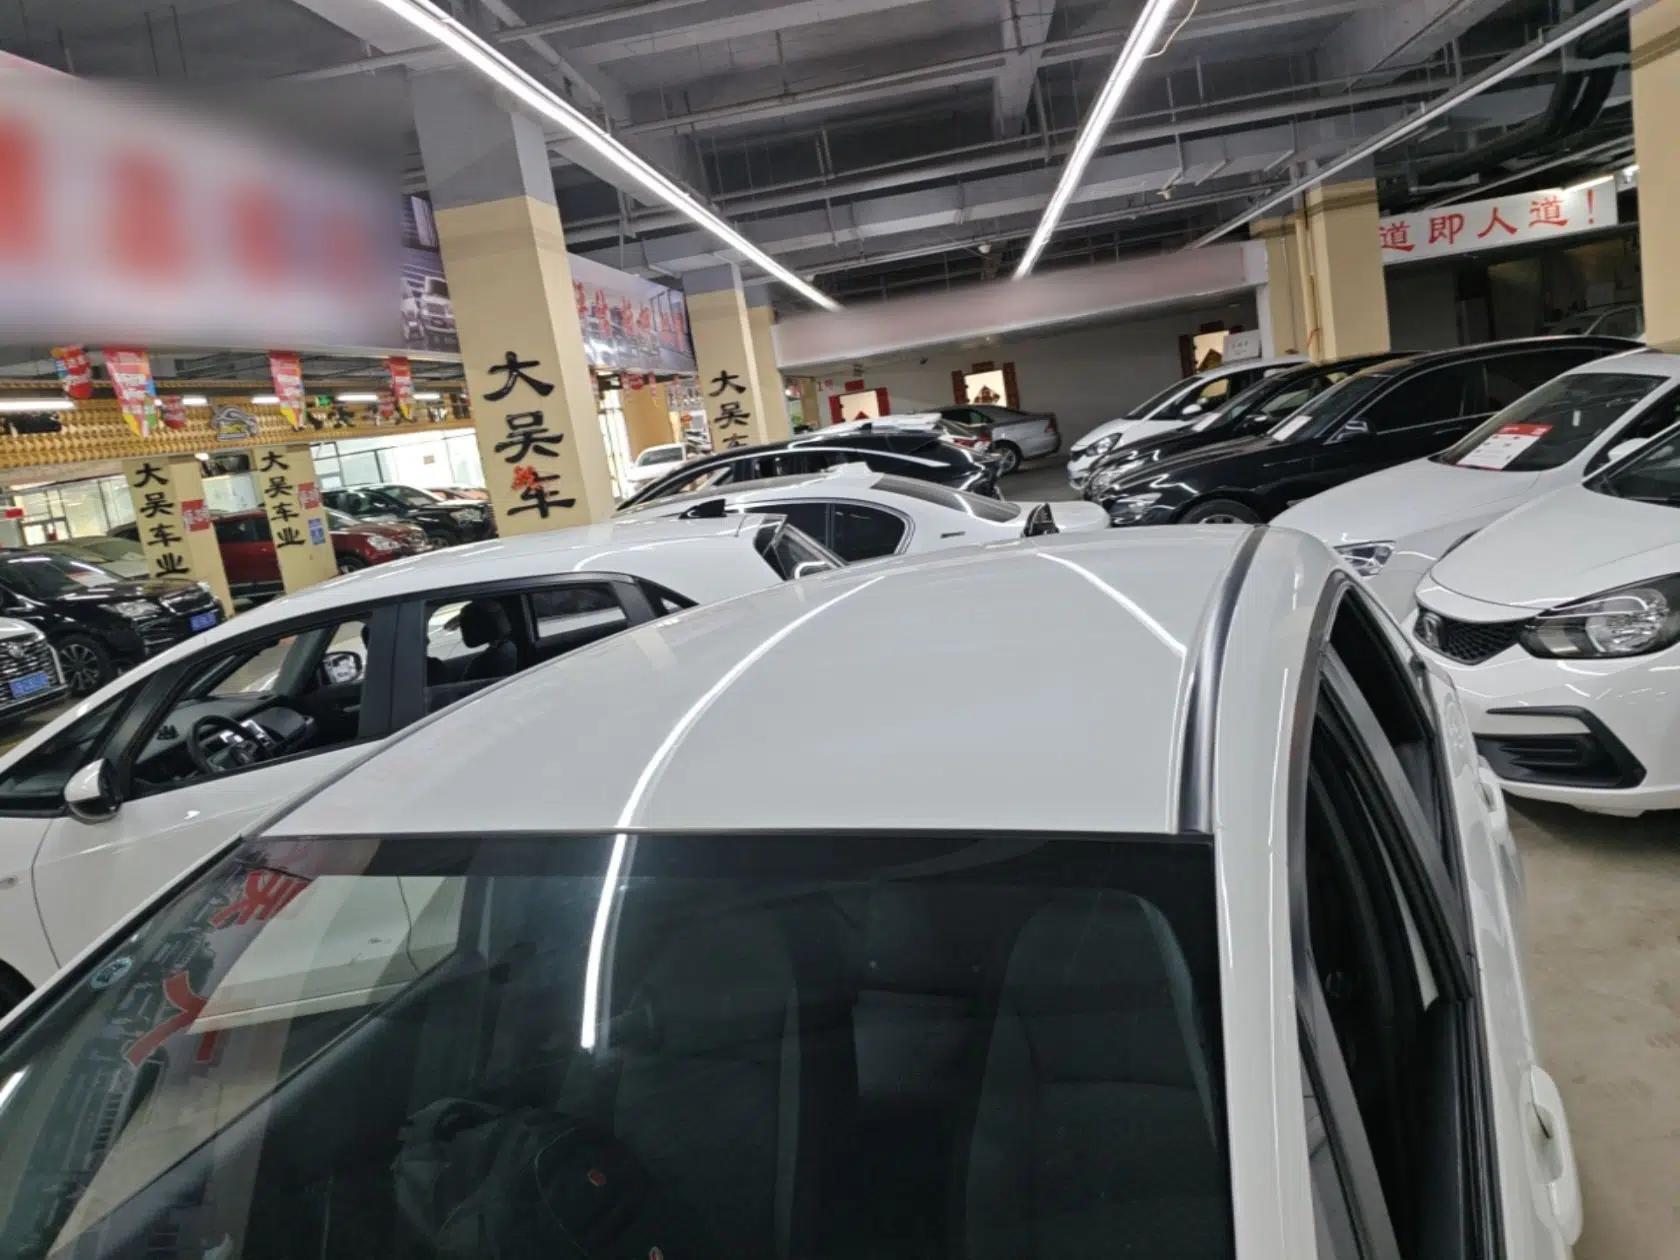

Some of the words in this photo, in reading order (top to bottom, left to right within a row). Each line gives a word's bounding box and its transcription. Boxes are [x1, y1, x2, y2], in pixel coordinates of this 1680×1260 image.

[134, 462, 190, 578] 大吴车业
[260, 450, 305, 549] 大吴车业
